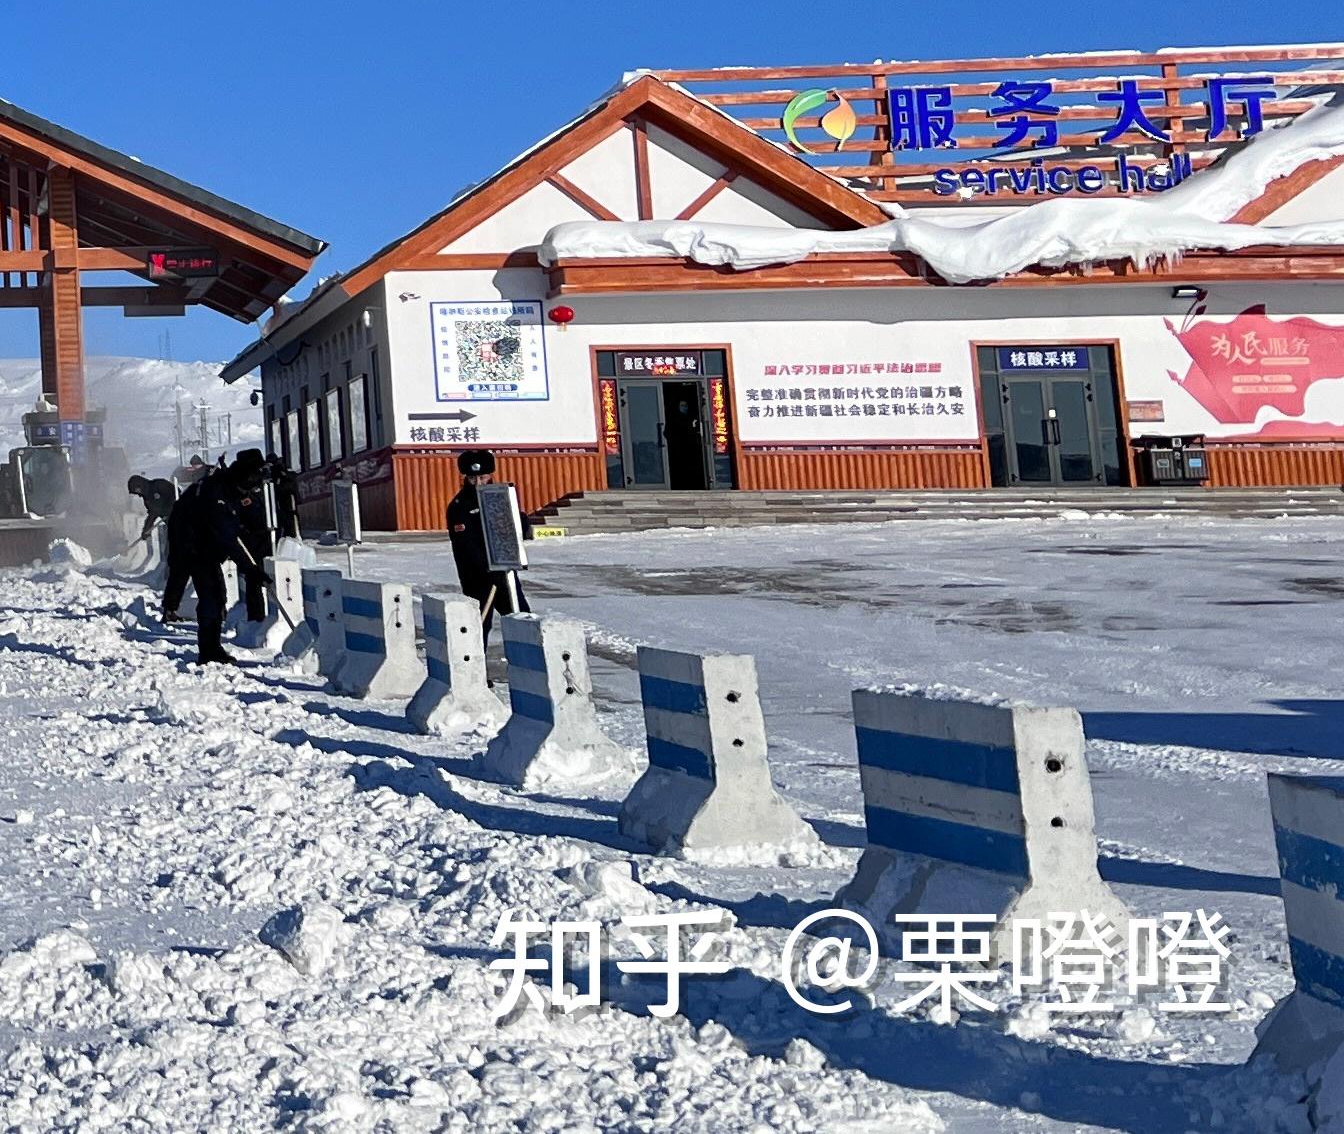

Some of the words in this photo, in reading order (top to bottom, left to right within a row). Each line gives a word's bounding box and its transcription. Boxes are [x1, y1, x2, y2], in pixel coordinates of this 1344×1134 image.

[888, 77, 1278, 150] 服务大厅
[934, 158, 1104, 196] service
[1119, 154, 1193, 192] hall
[1010, 351, 1077, 366] 核酸采样
[1211, 331, 1310, 365] 为人民服务
[410, 426, 481, 442] 核酸采样
